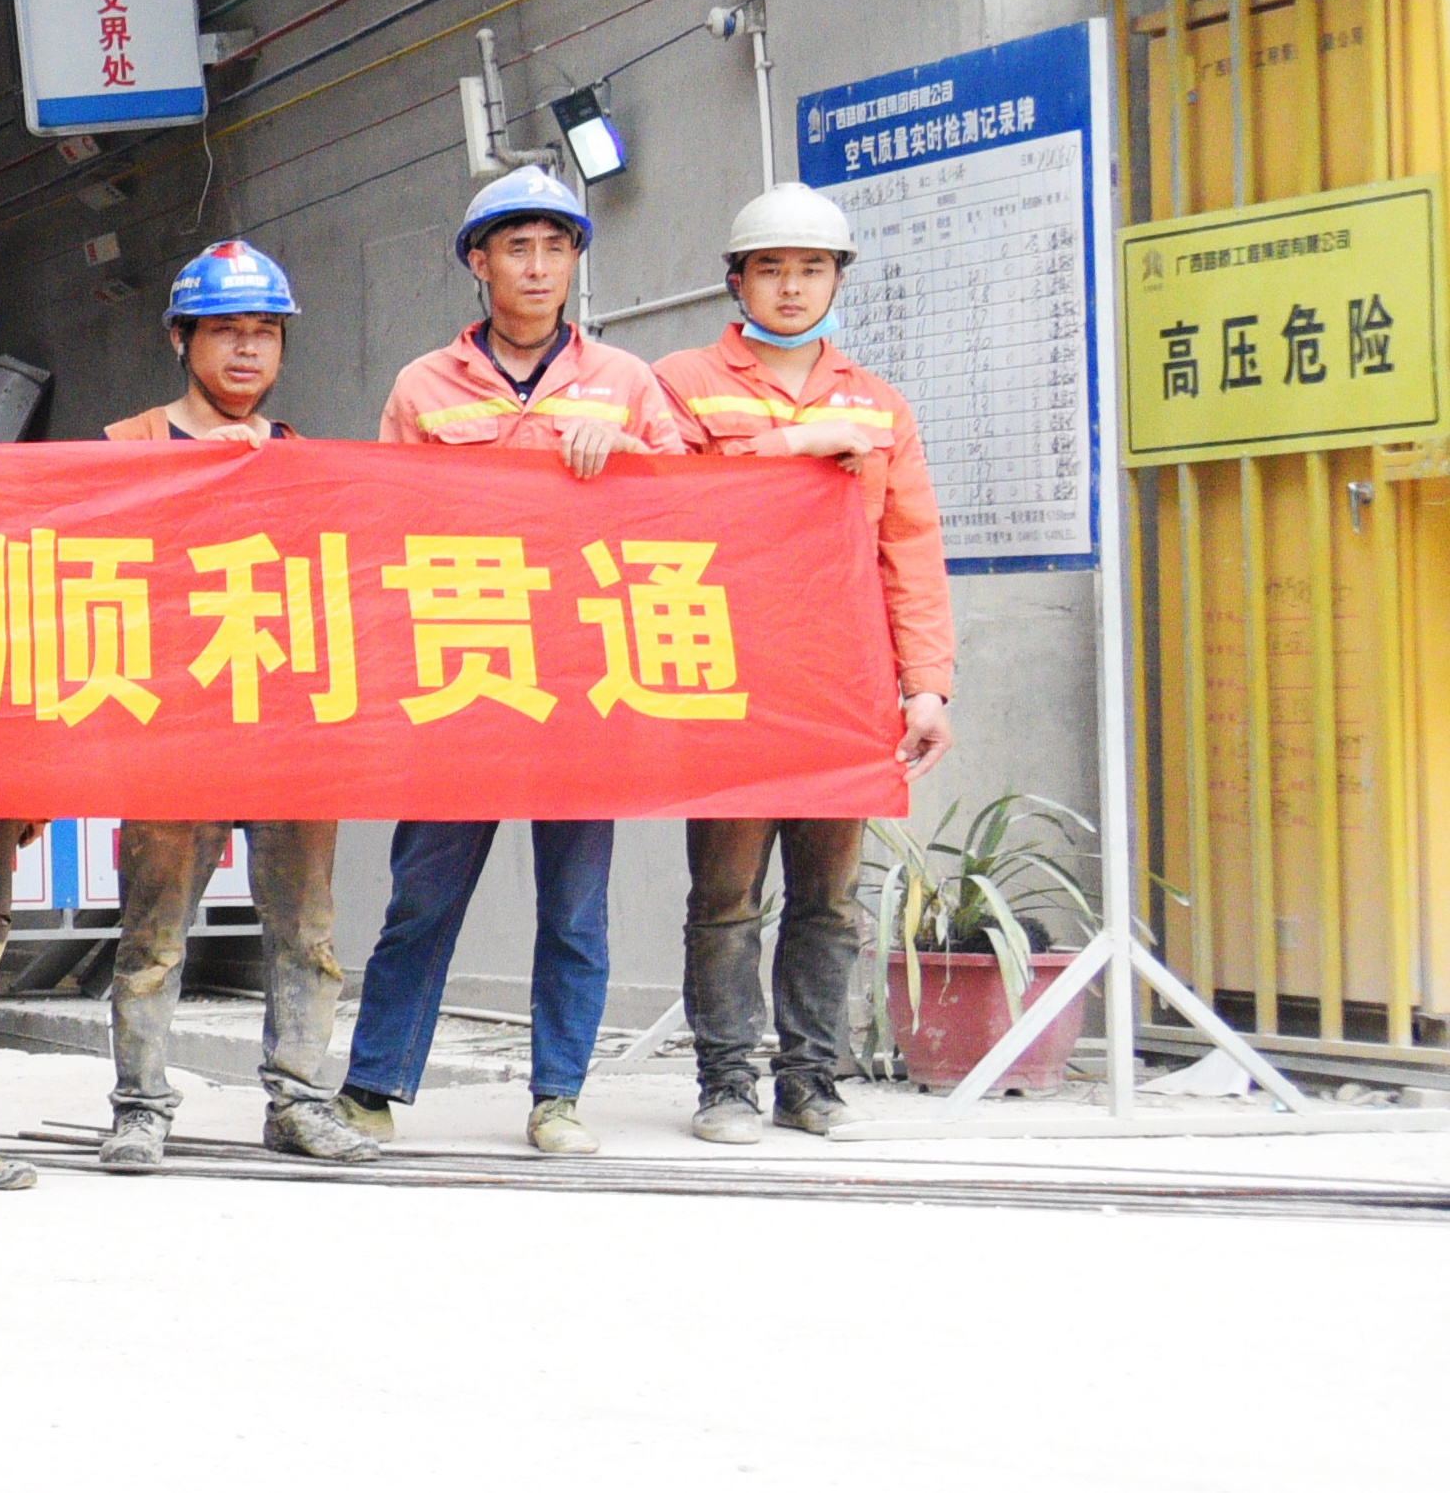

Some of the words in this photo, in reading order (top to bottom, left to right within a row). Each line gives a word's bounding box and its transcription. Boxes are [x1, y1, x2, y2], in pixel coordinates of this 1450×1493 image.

[844, 96, 1036, 172] 空气质量实时检测记录牌
[1159, 293, 1395, 400] 高压危险
